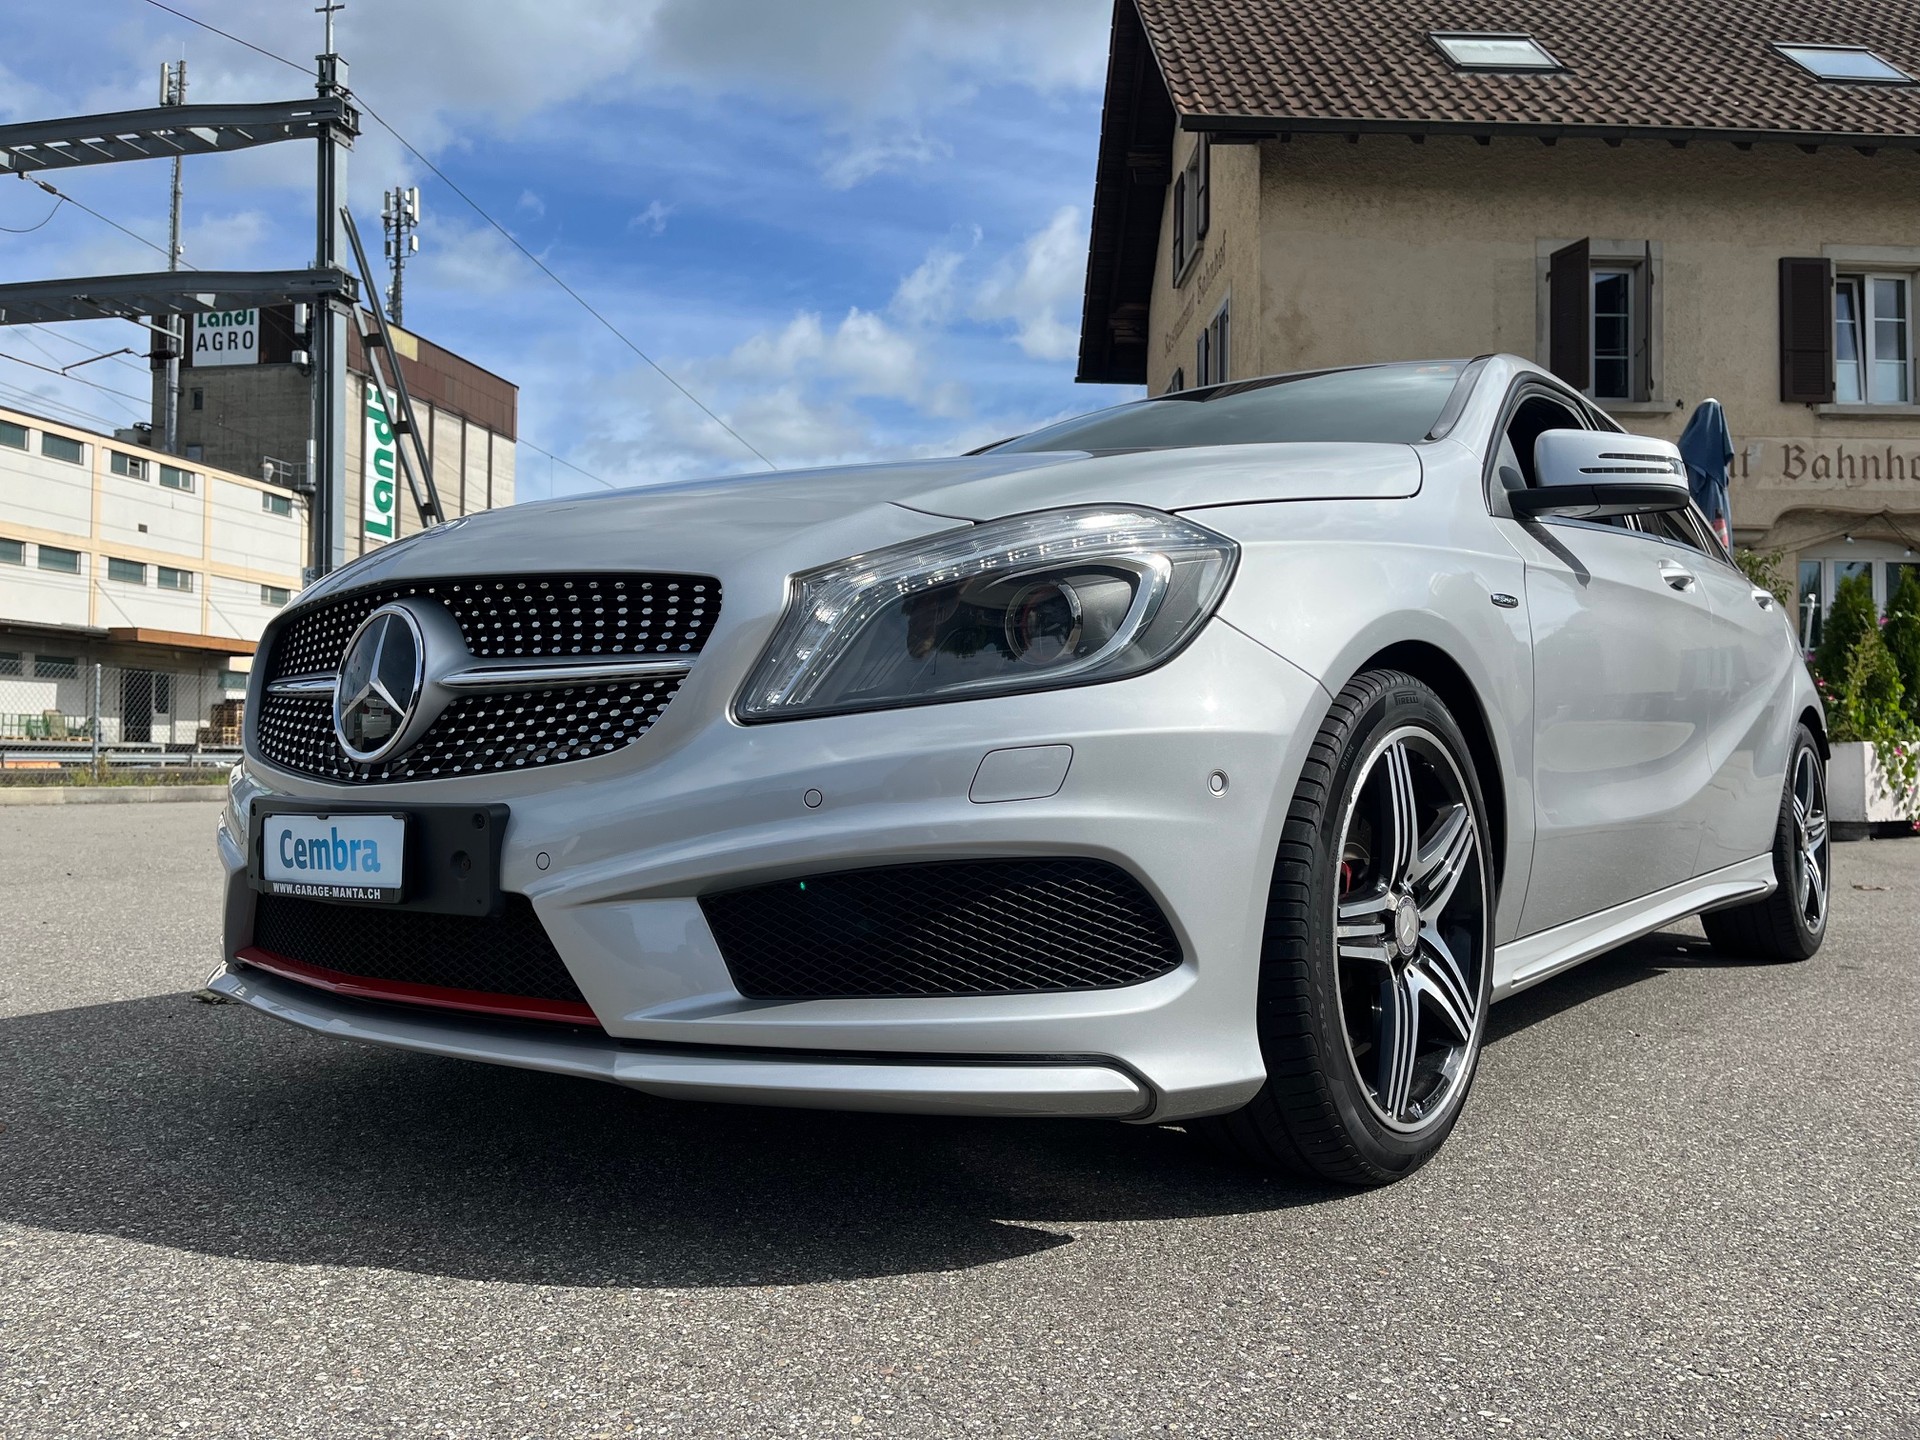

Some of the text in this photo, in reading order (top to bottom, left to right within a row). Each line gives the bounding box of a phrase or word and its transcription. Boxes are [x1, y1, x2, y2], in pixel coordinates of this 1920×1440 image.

[196, 330, 254, 352] AGRO
[1393, 691, 1419, 706] PIRELLI
[279, 827, 381, 873] Cembra
[272, 882, 381, 900] WWW.GARAGE-MANTA.CH
